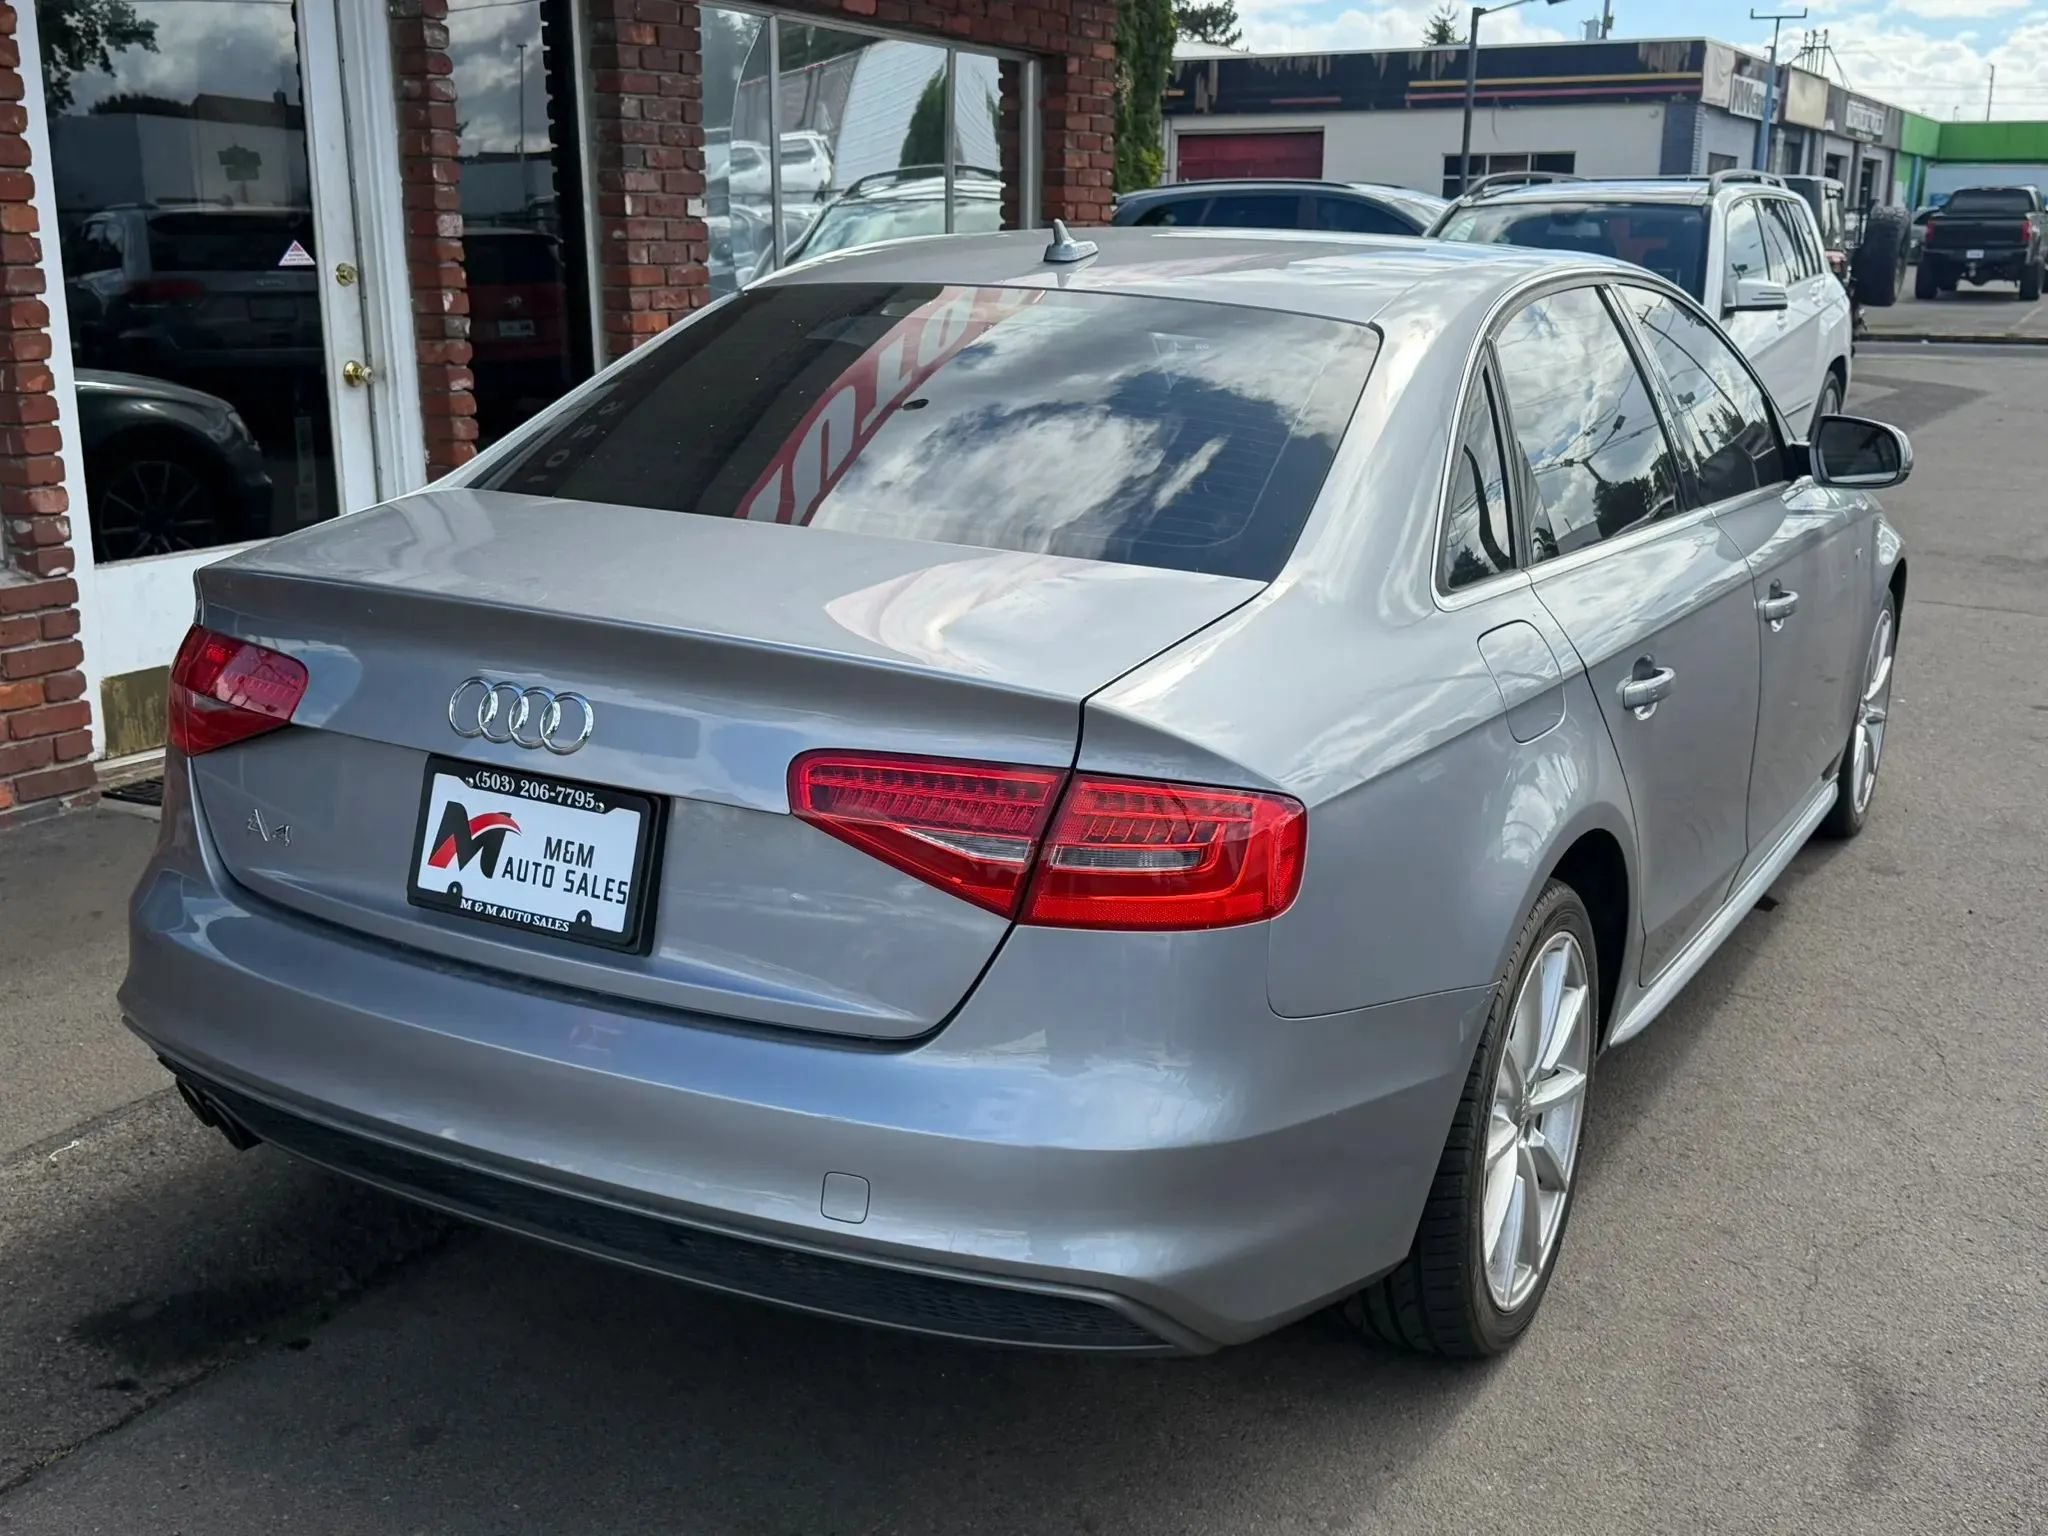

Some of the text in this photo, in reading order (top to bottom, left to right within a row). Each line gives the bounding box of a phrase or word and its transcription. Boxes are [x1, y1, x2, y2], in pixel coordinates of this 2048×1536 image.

[475, 771, 595, 809] (503) 206-7795
[247, 808, 290, 847] A4
[543, 836, 595, 868] M&M
[501, 856, 629, 905] AUTO SALES
[460, 898, 570, 932] M & M AUTO SALES
